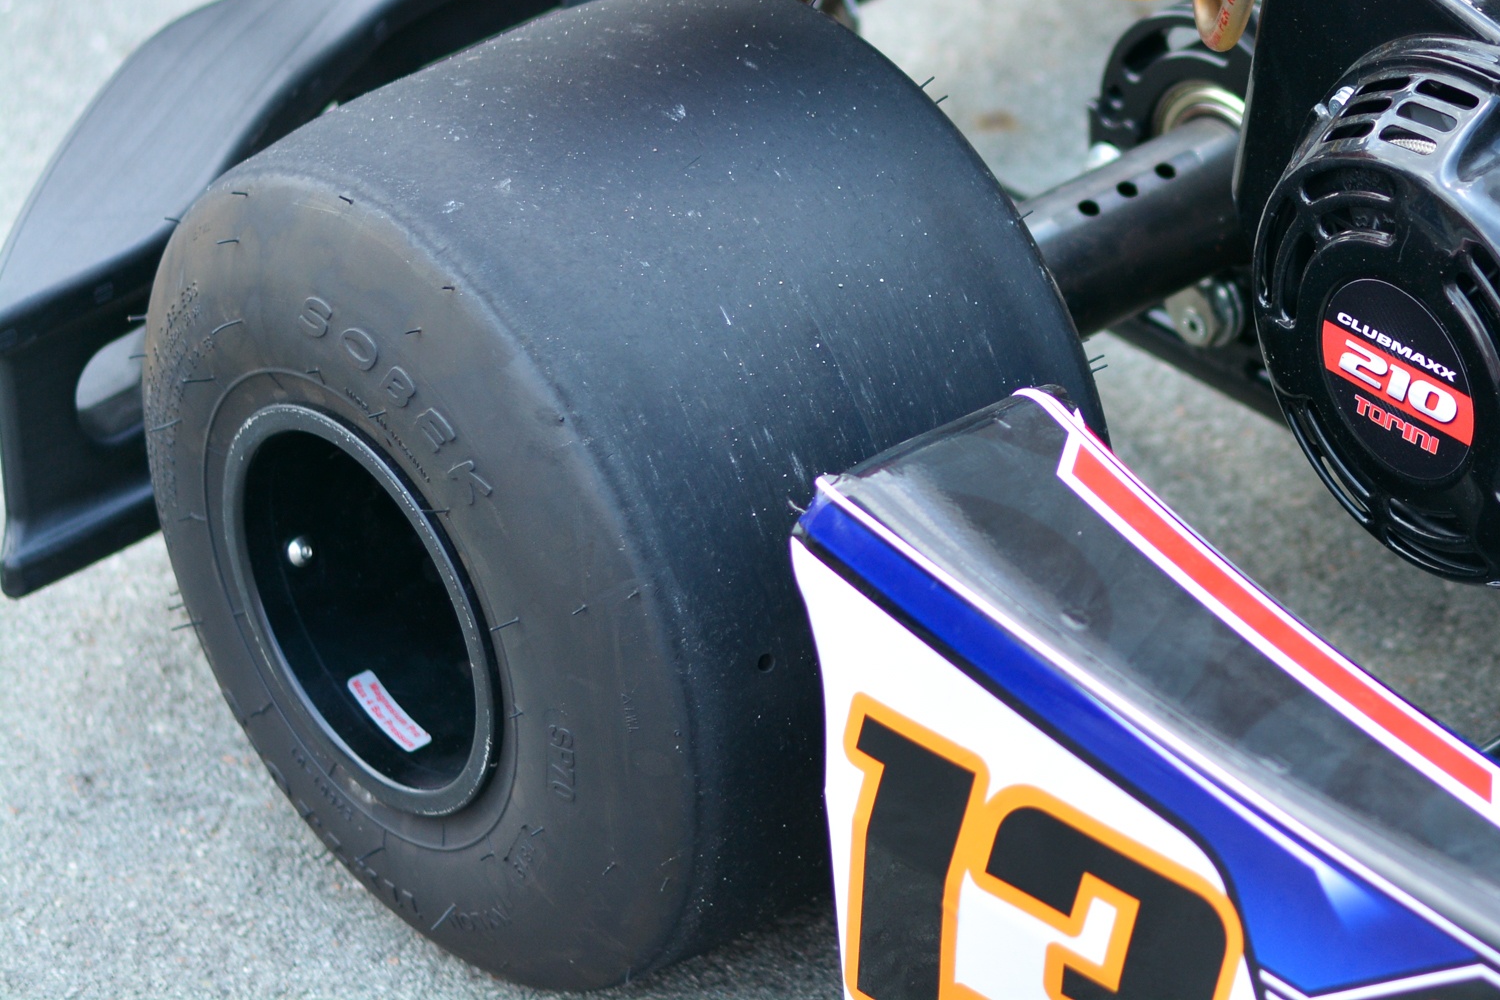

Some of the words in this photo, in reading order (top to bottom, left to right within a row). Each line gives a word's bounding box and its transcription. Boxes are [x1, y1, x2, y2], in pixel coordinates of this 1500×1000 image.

[1337, 311, 1457, 382] CLUBMAXX
[1338, 339, 1458, 423] 210
[298, 296, 494, 506] SOBEK
[1354, 394, 1440, 455] TORINI
[843, 691, 1244, 1000] 13
